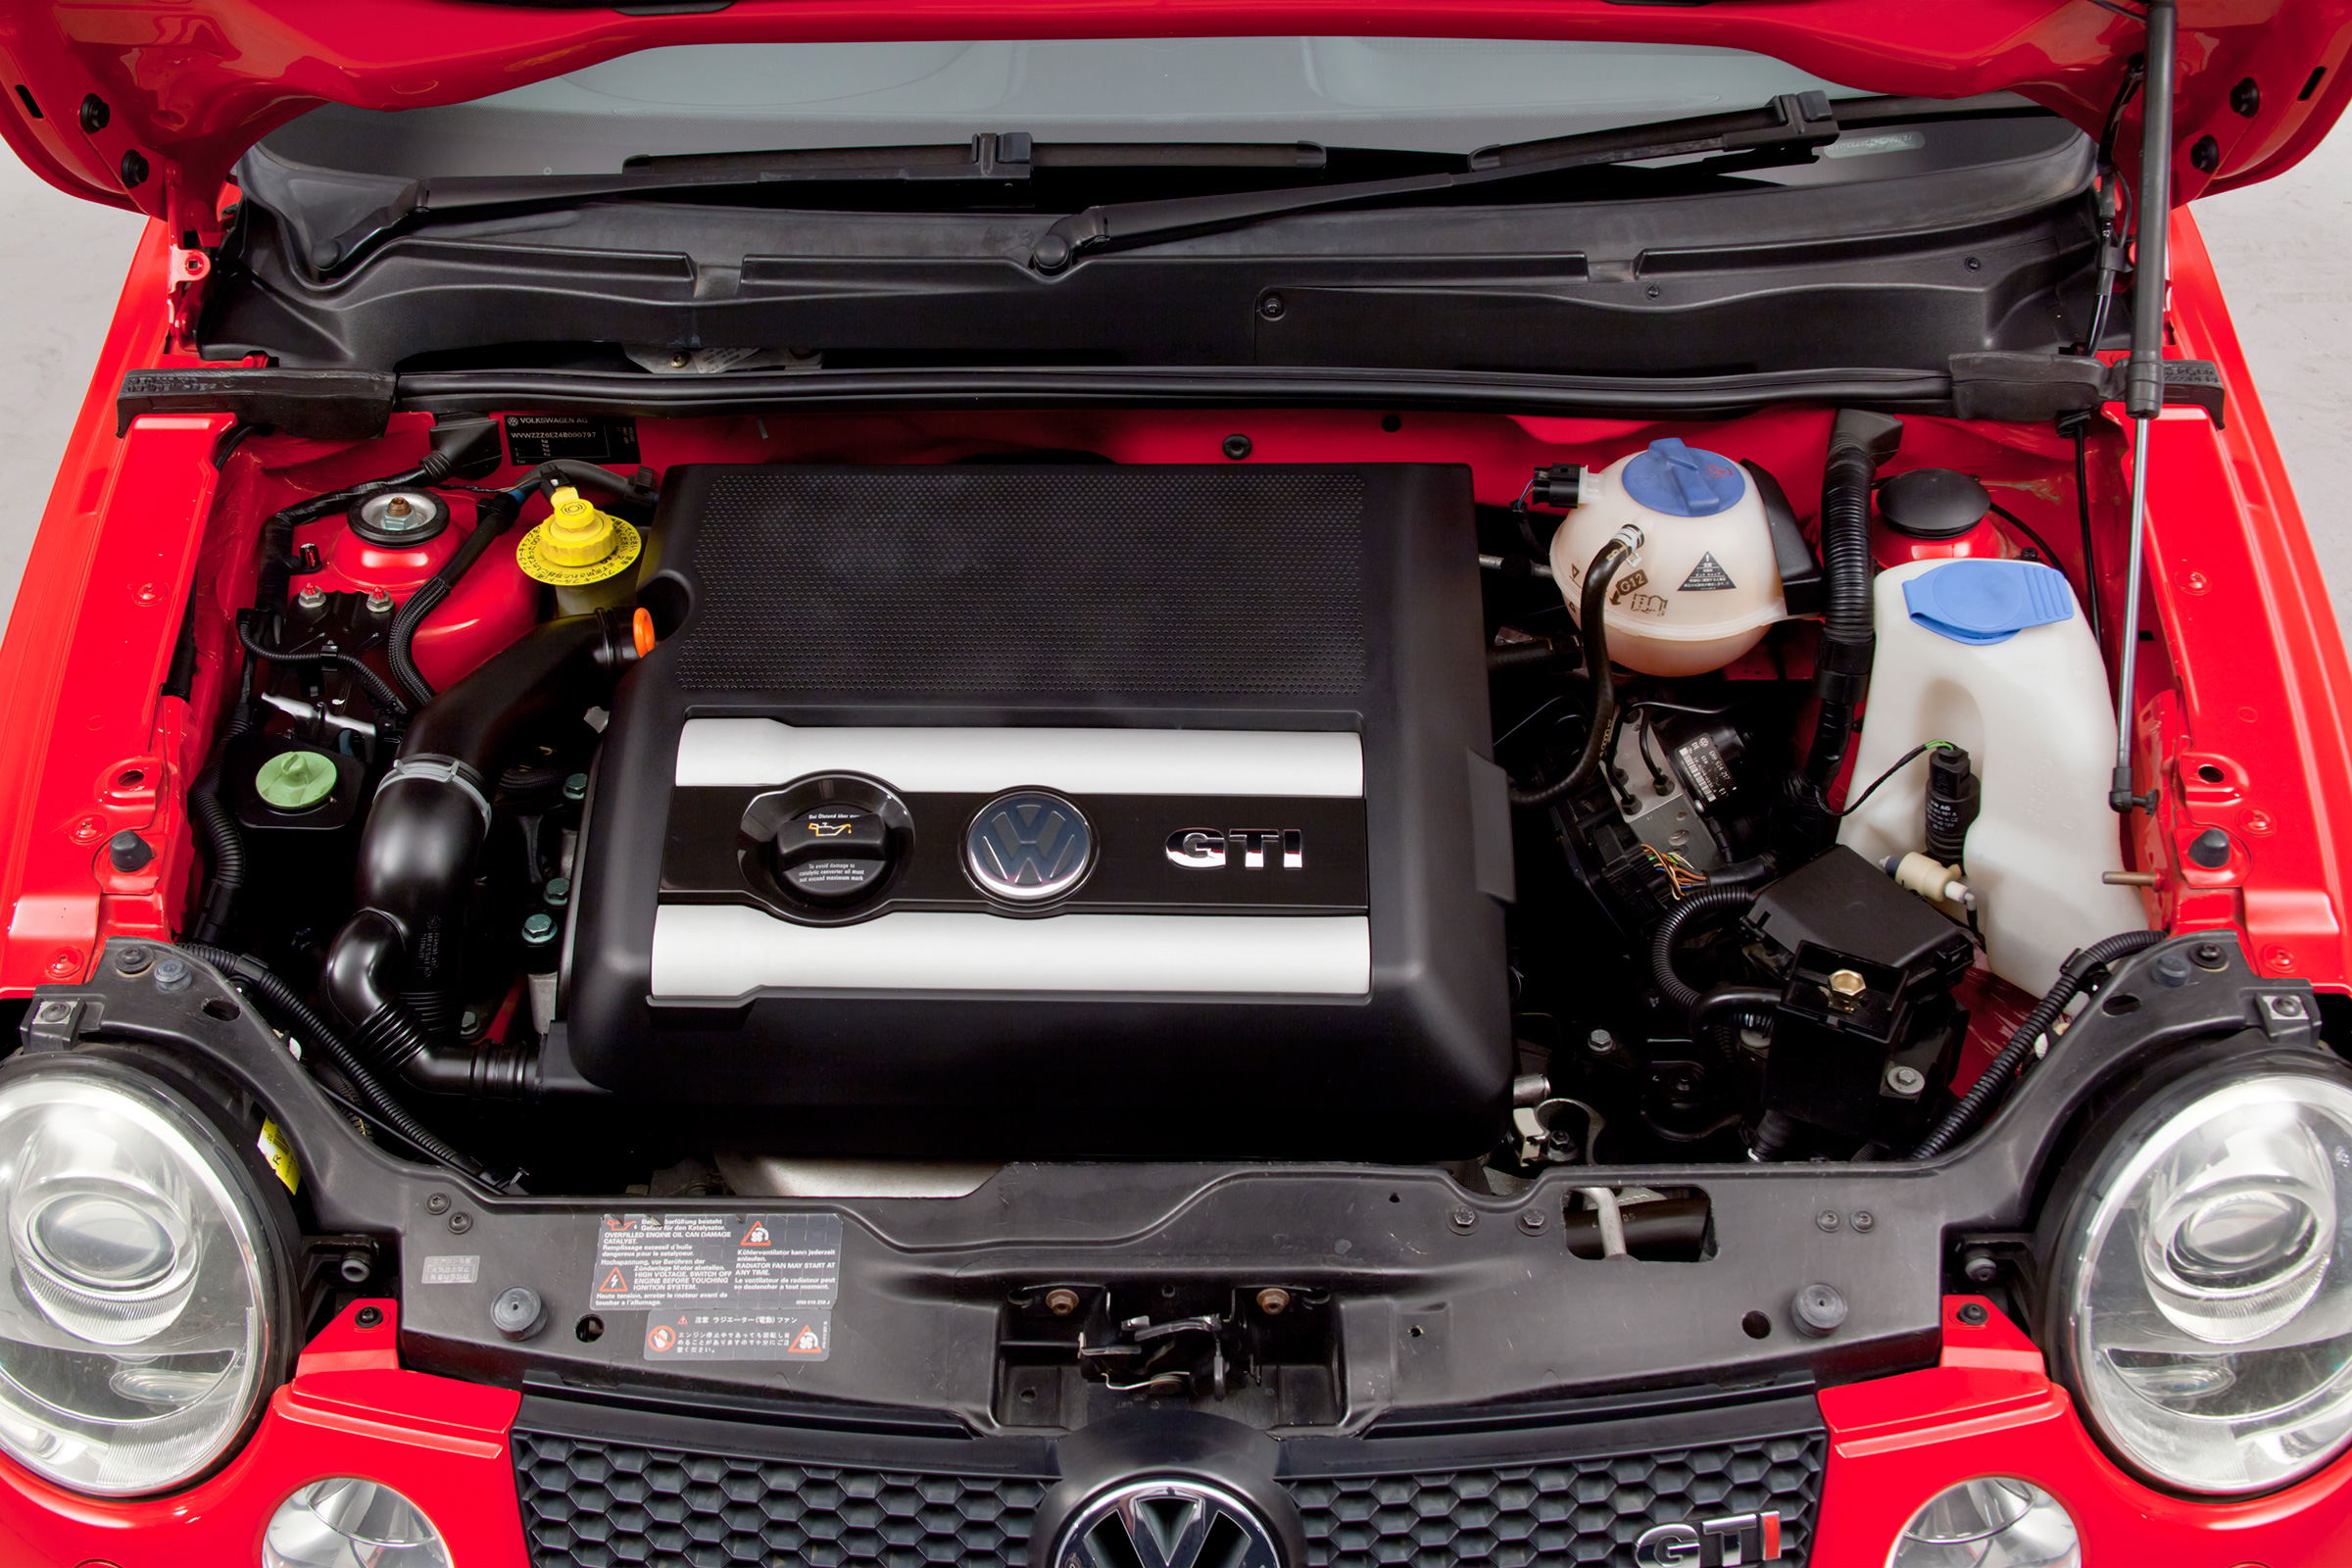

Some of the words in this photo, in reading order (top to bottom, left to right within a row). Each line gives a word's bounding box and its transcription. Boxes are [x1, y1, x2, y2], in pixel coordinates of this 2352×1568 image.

[1621, 573, 1644, 592] G12
[1166, 827, 1302, 870] GTI
[1635, 1510, 1782, 1568] GTI
